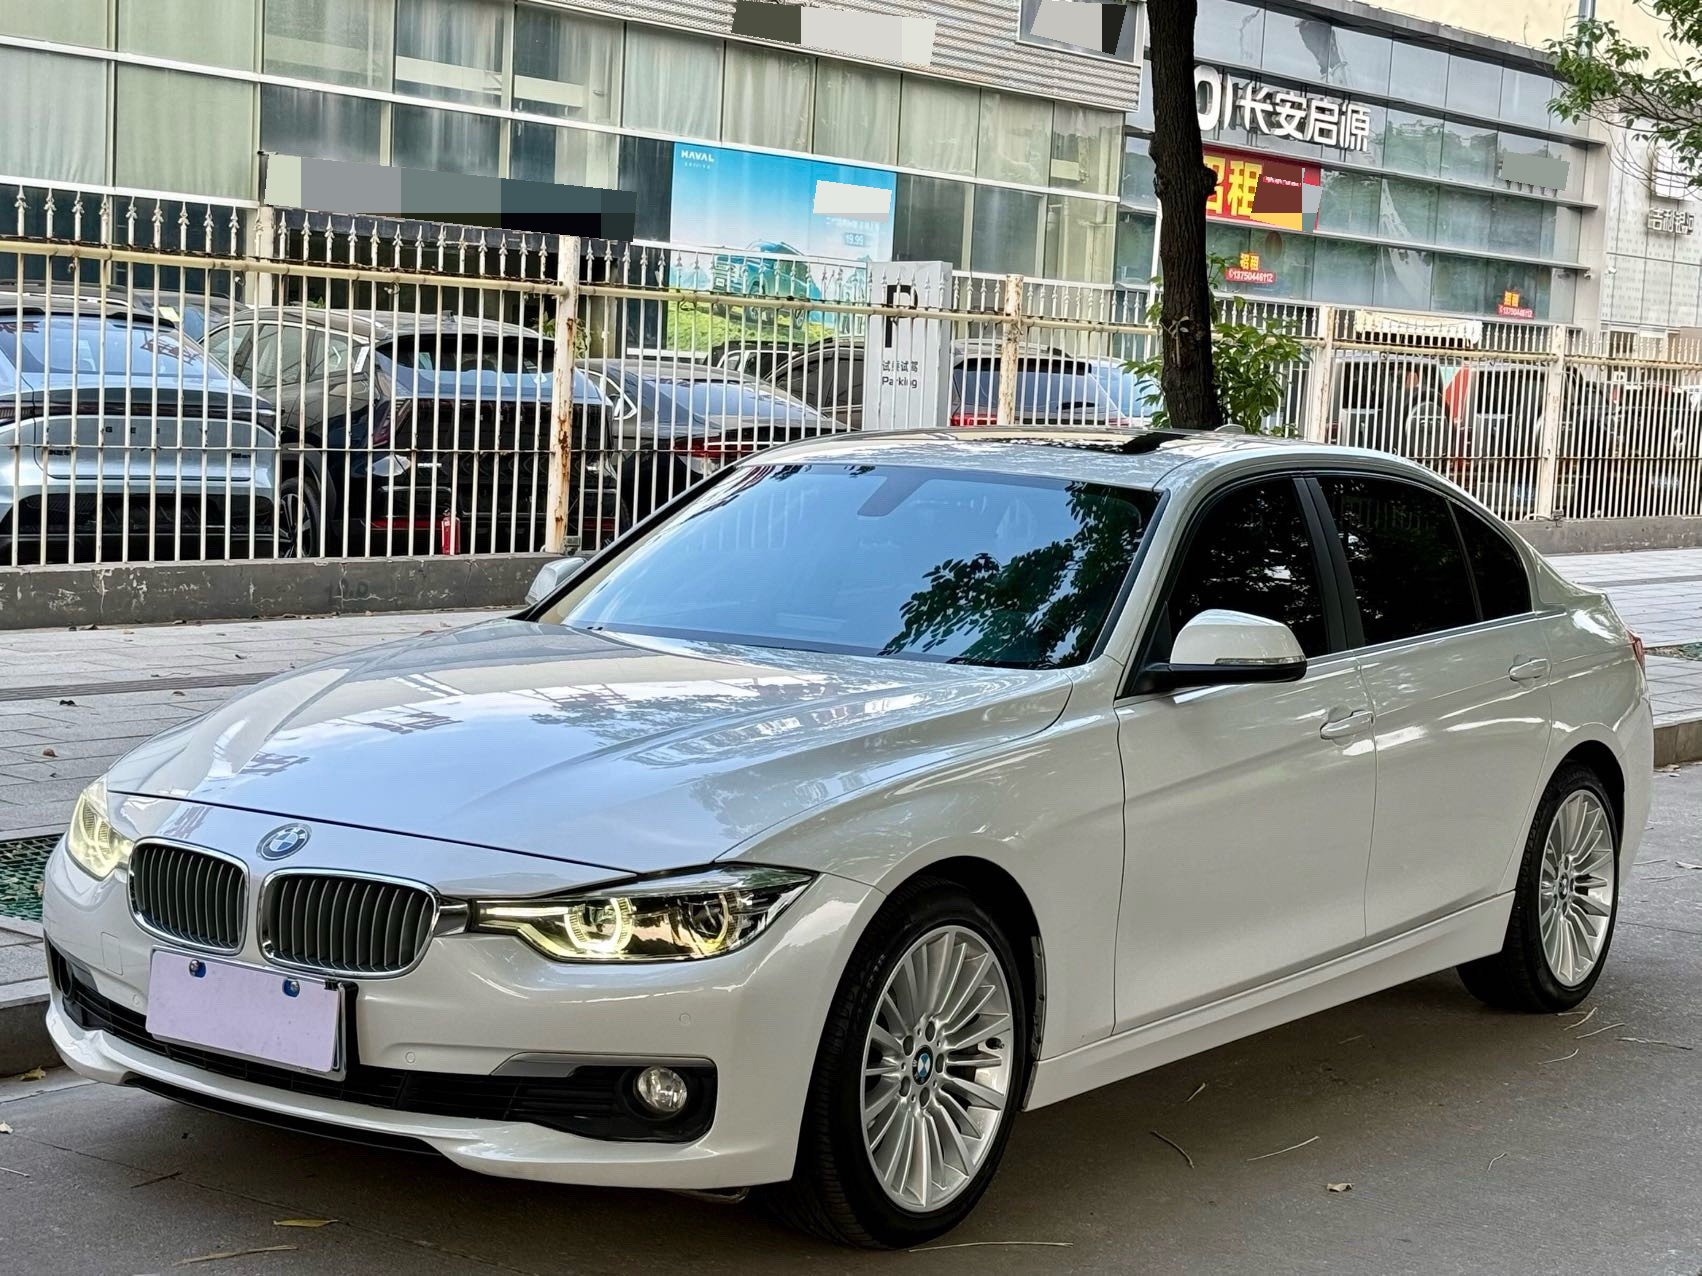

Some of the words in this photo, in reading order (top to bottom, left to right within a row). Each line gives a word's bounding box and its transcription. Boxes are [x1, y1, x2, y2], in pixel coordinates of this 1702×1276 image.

[1236, 81, 1371, 151] 长安启源
[681, 150, 715, 162] HAVAL
